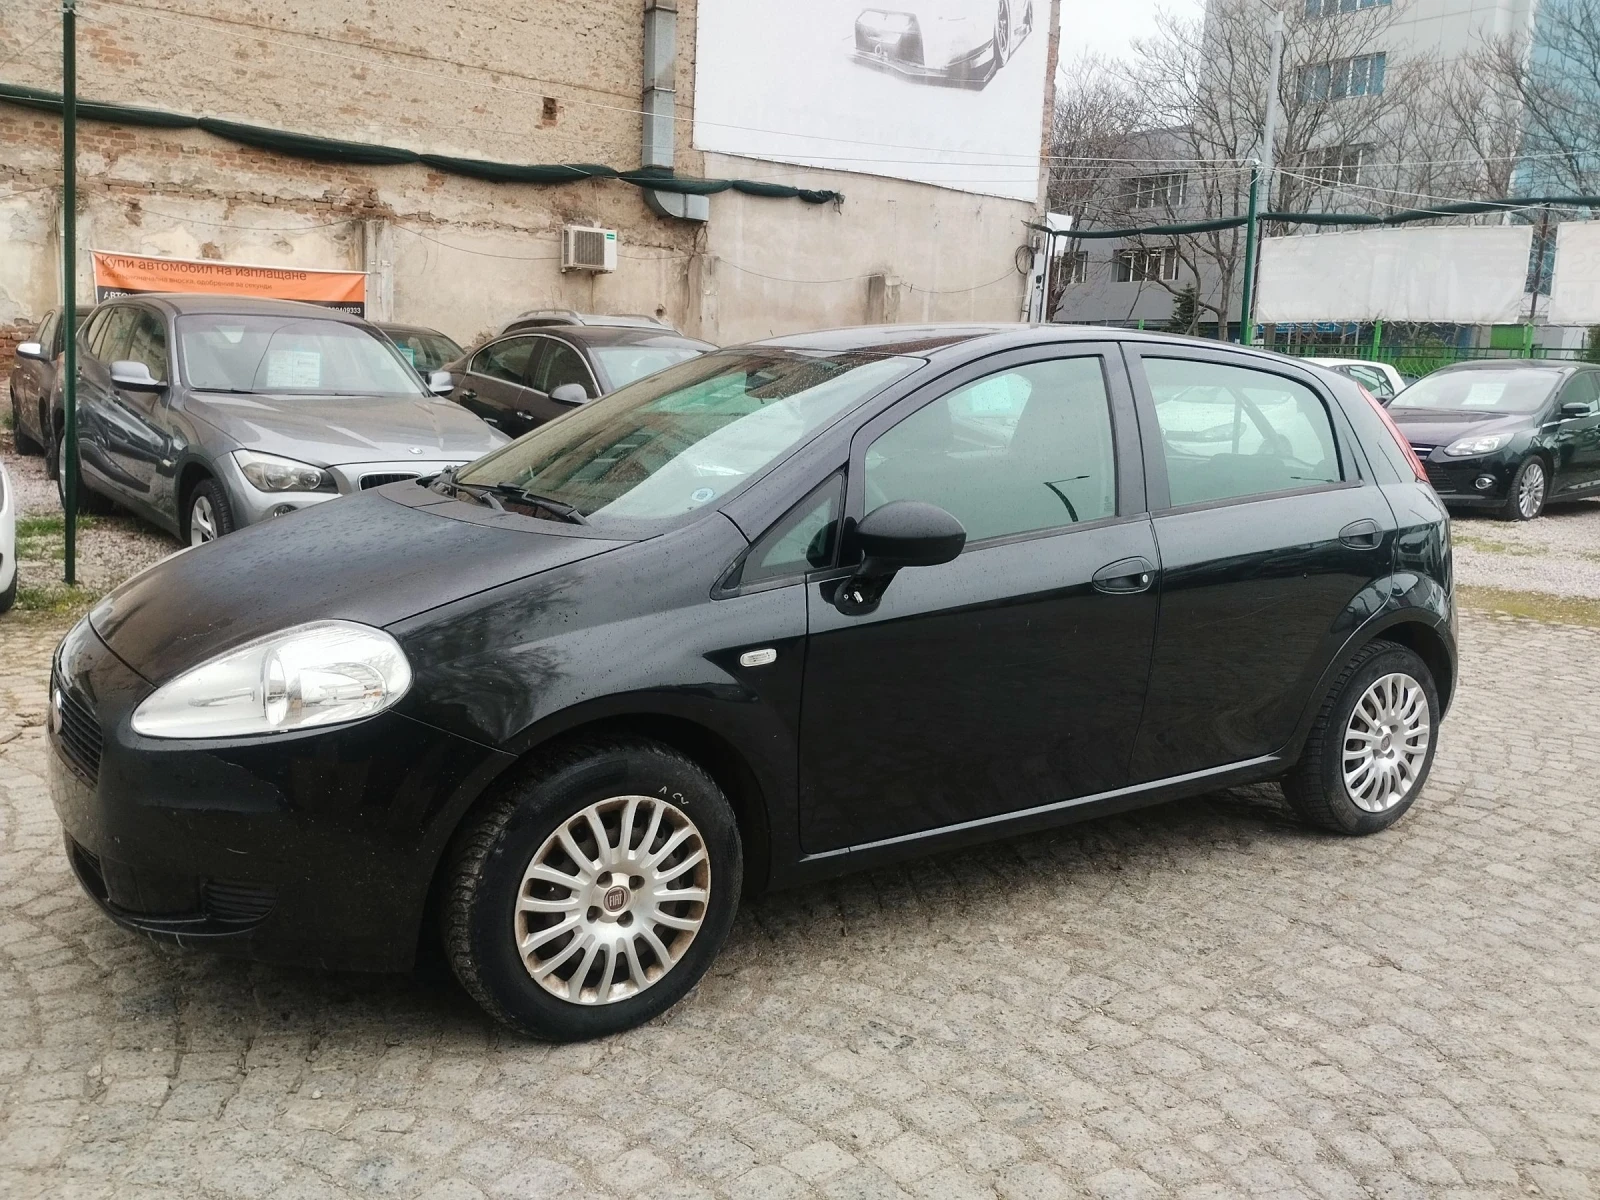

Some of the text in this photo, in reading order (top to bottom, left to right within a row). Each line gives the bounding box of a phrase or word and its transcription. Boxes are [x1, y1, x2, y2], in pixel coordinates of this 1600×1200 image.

[101, 255, 307, 281] Купи автомобил на изплащане
[609, 893, 622, 907] FIAT
